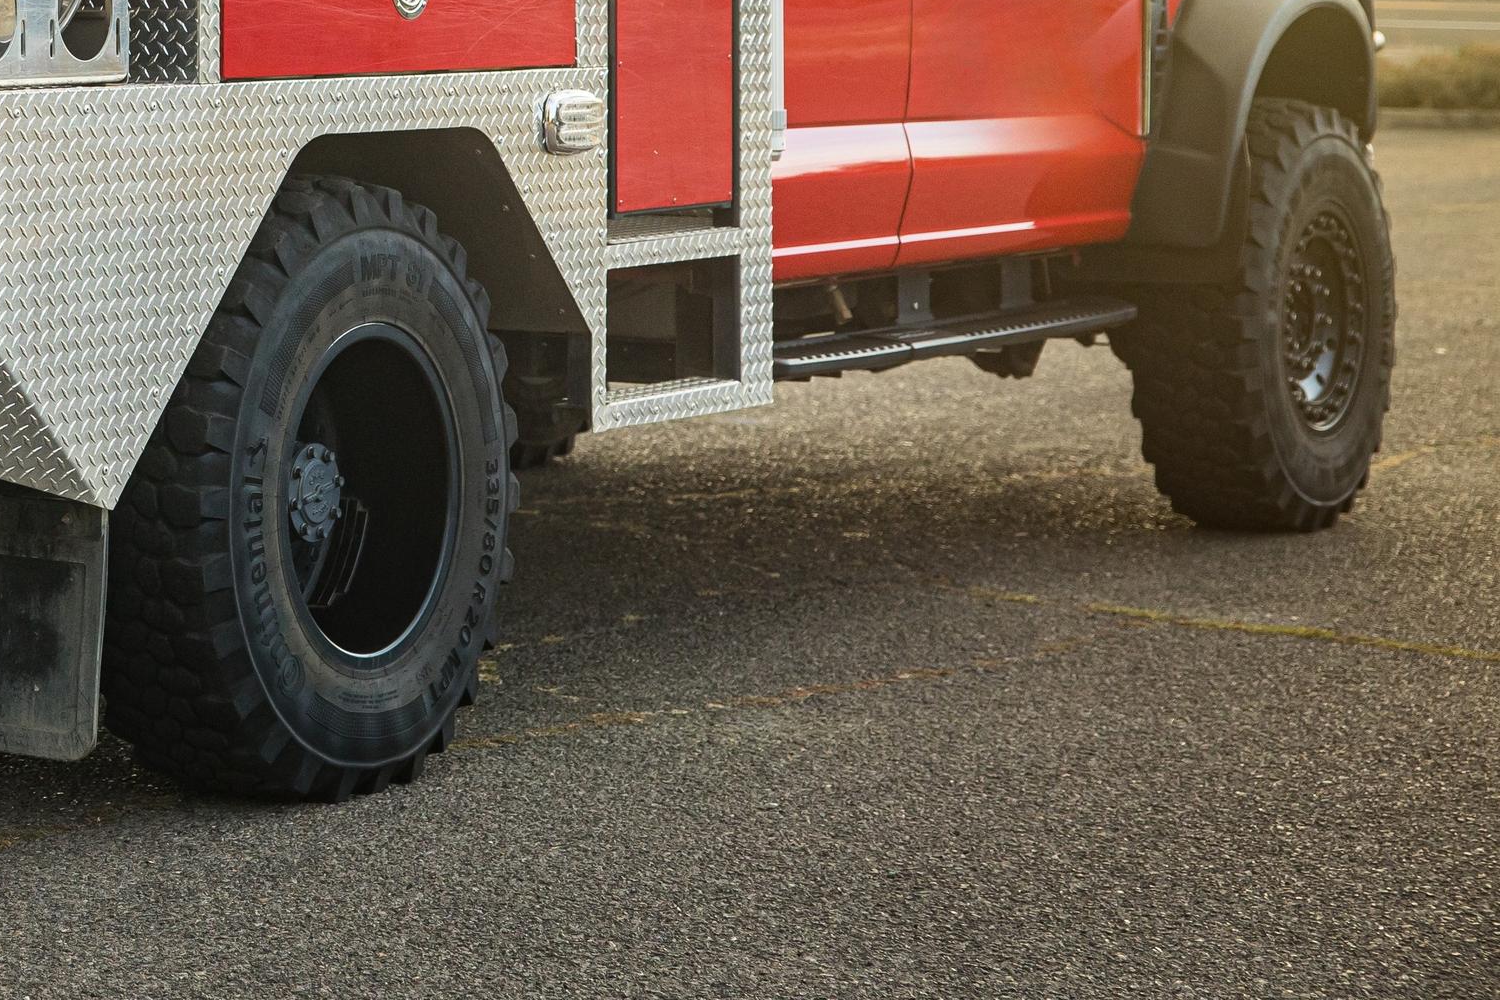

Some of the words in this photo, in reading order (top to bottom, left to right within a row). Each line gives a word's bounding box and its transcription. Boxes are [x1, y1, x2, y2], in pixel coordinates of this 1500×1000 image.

[359, 253, 401, 282] MPT
[478, 458, 501, 577] 335/80
[243, 474, 306, 695] Continental
[471, 581, 487, 604] R
[458, 605, 482, 649] 20
[426, 647, 462, 707] MPT
